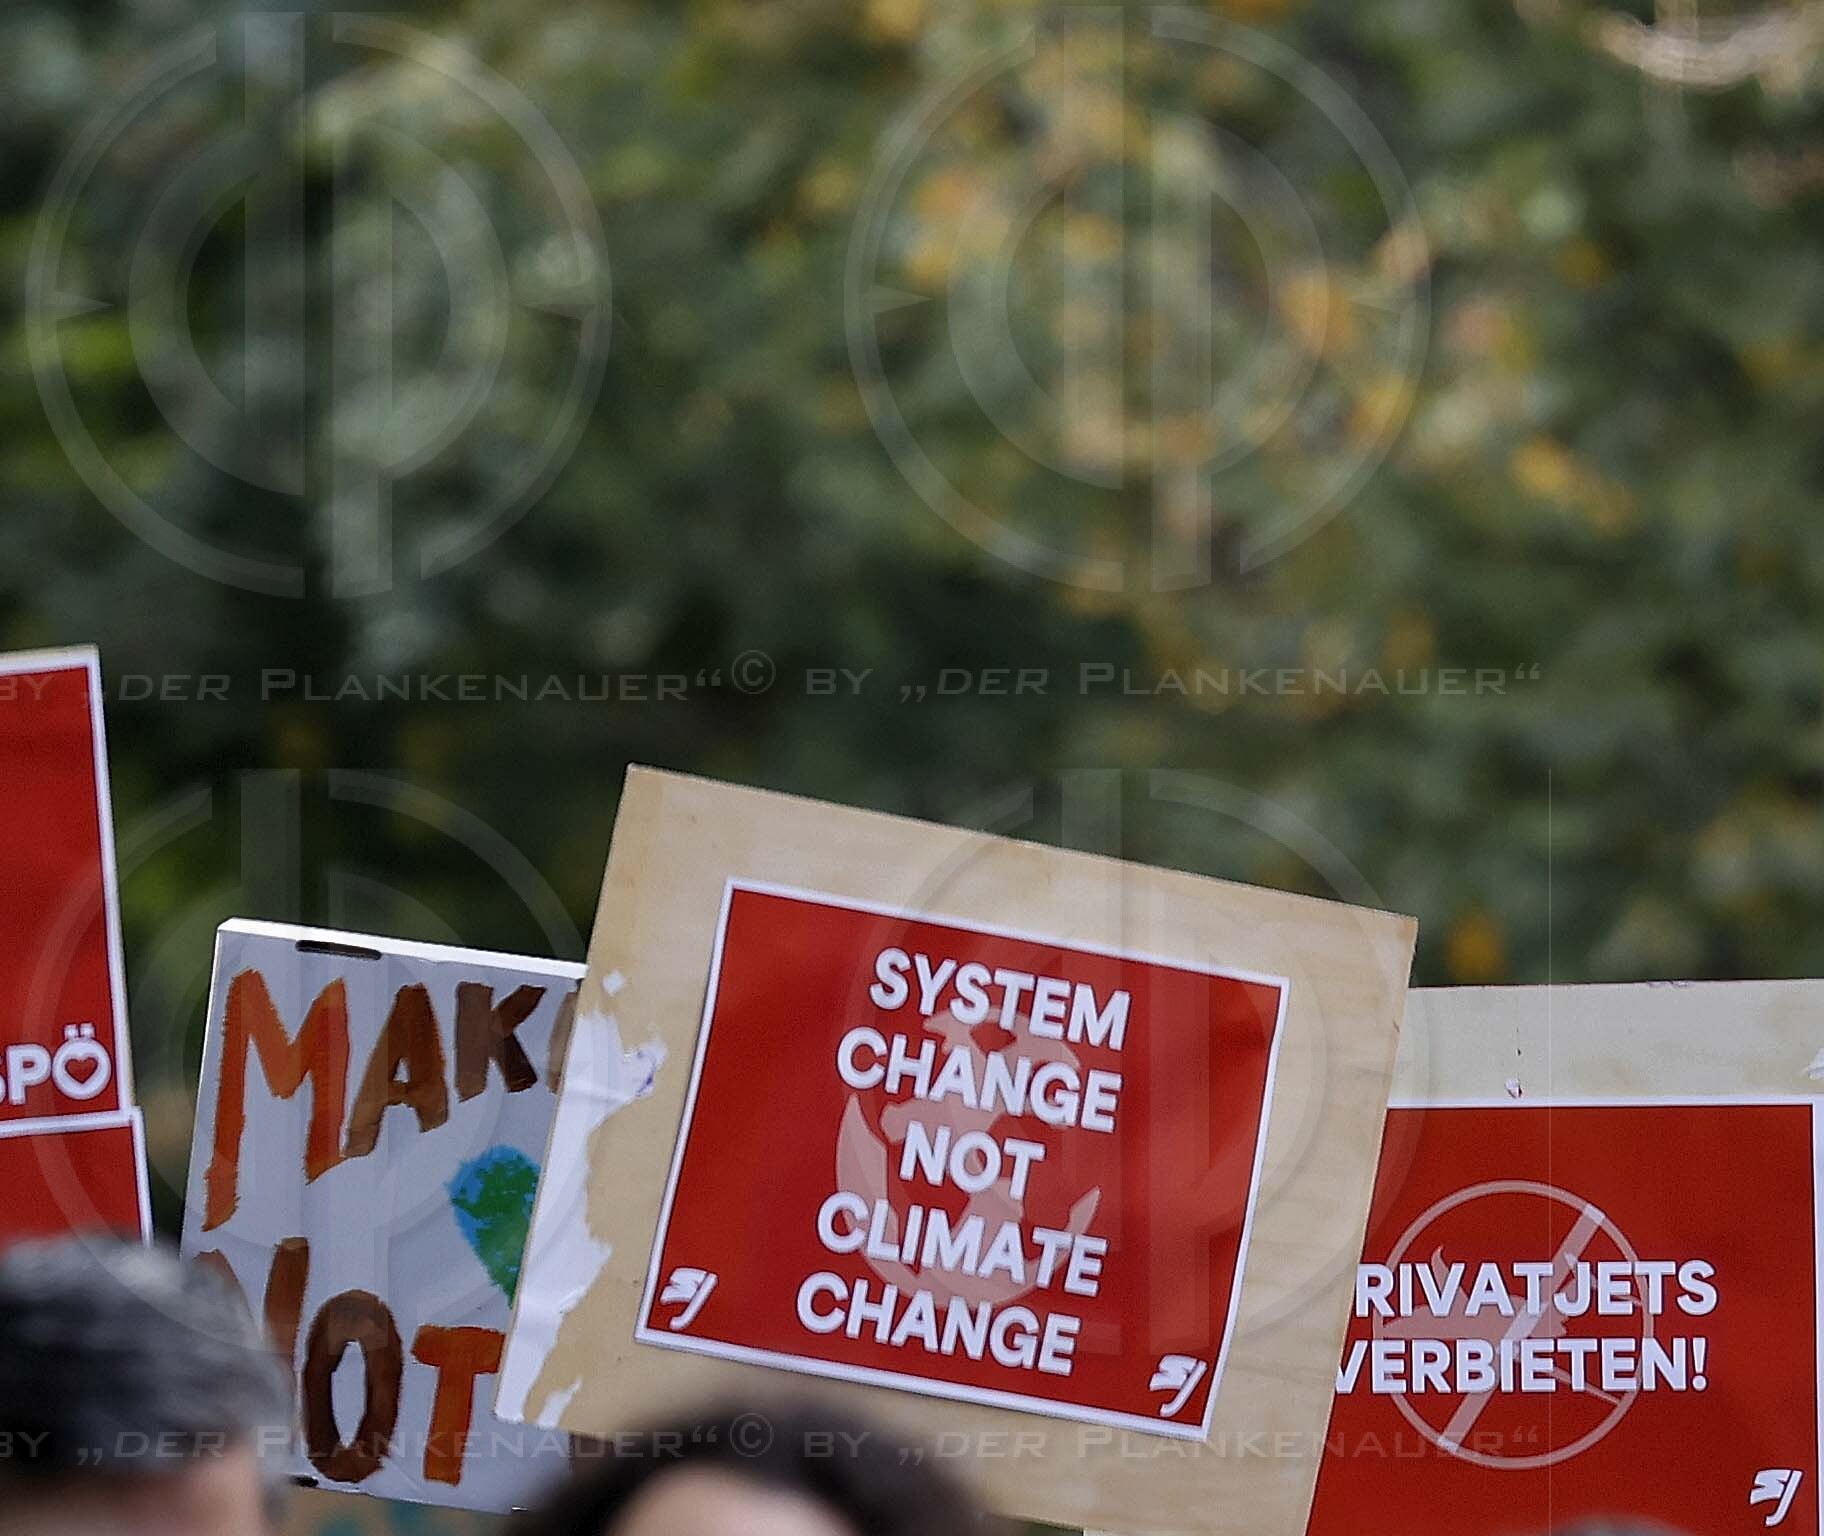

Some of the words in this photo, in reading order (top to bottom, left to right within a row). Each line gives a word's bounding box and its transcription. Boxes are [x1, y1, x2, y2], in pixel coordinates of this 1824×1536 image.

[870, 949, 1128, 1051] SYSTEM
[202, 968, 579, 1234] MAK
[837, 1027, 1121, 1131] CHANGE
[901, 1121, 1044, 1199] NOT
[817, 1193, 1106, 1294] CLIMATE
[1356, 1263, 1716, 1315] RIVATJETS
[797, 1273, 1081, 1374] CHANGE
[1336, 1339, 1705, 1392] VERBIETEN!
